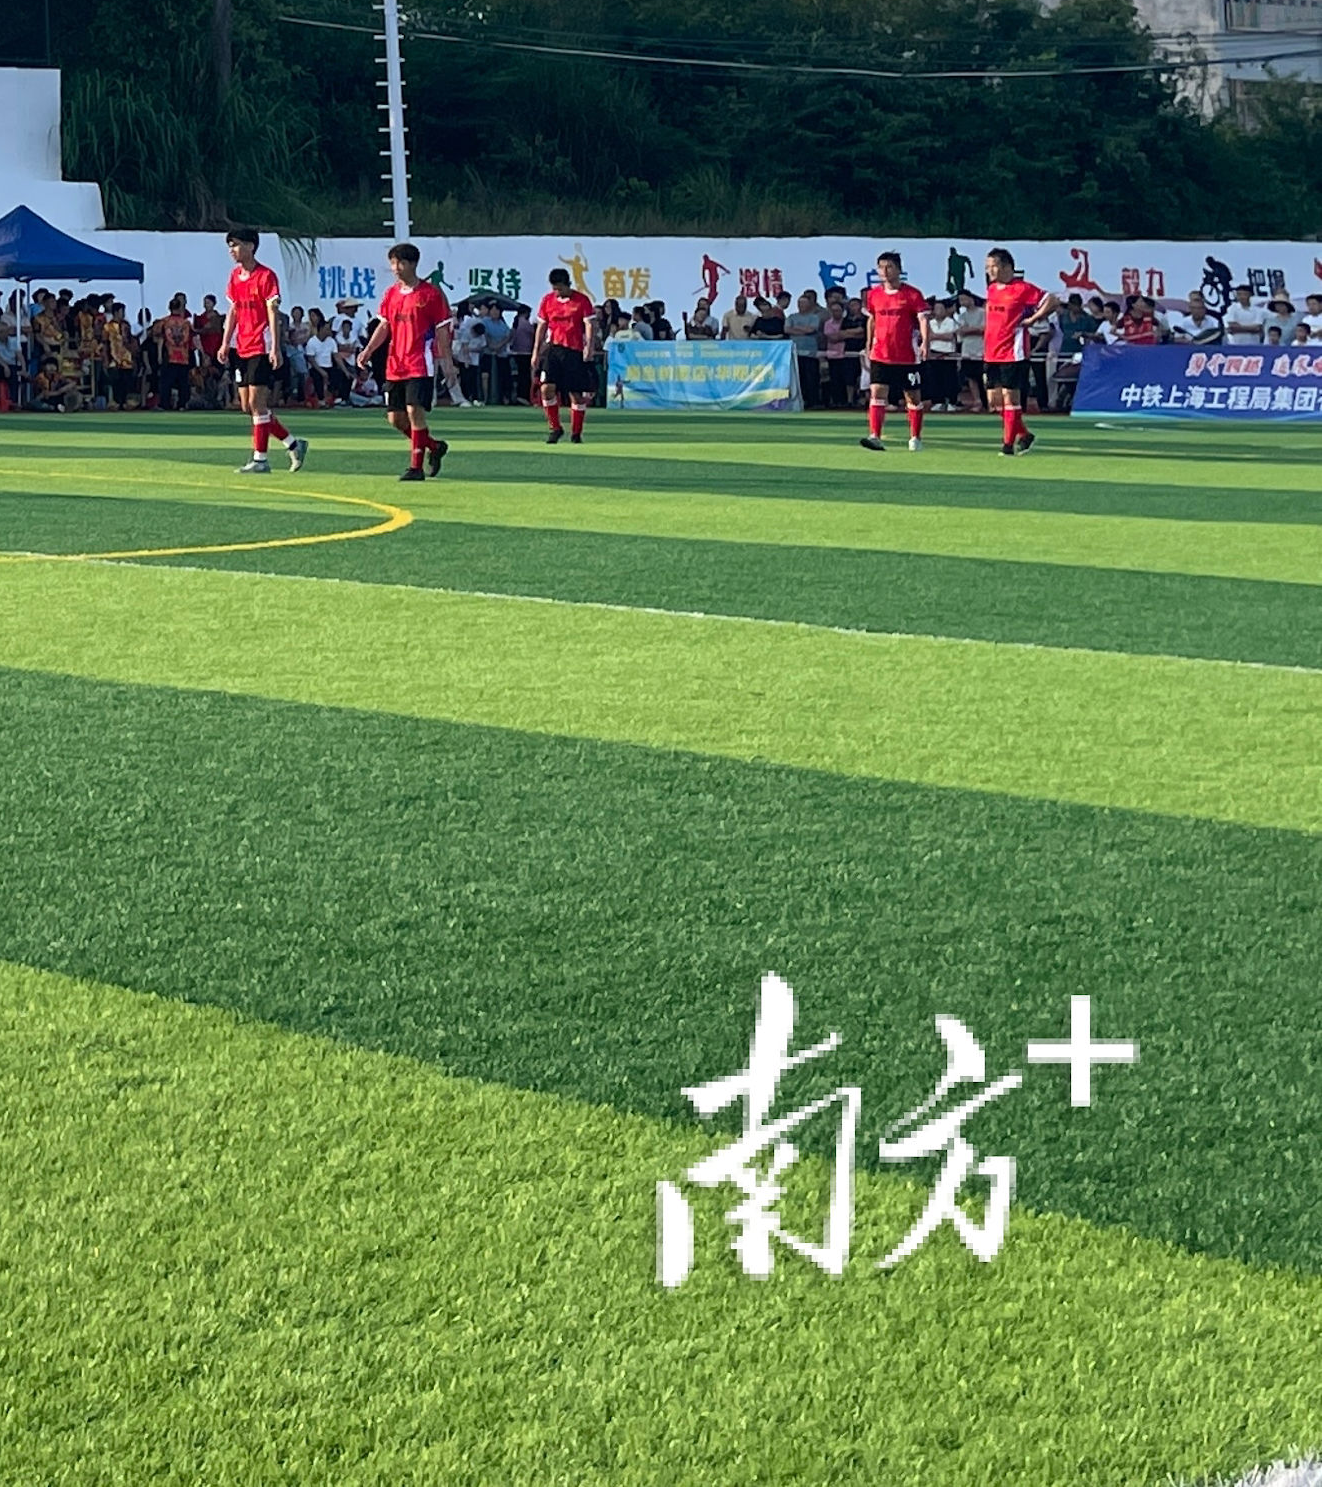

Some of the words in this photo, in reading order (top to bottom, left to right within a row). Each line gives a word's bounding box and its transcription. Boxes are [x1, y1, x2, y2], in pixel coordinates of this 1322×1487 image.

[318, 266, 376, 299] 挑战
[469, 268, 521, 300] 坚持
[602, 266, 651, 299] 奋发
[739, 268, 784, 298] 激情
[1121, 267, 1165, 296] 毅力
